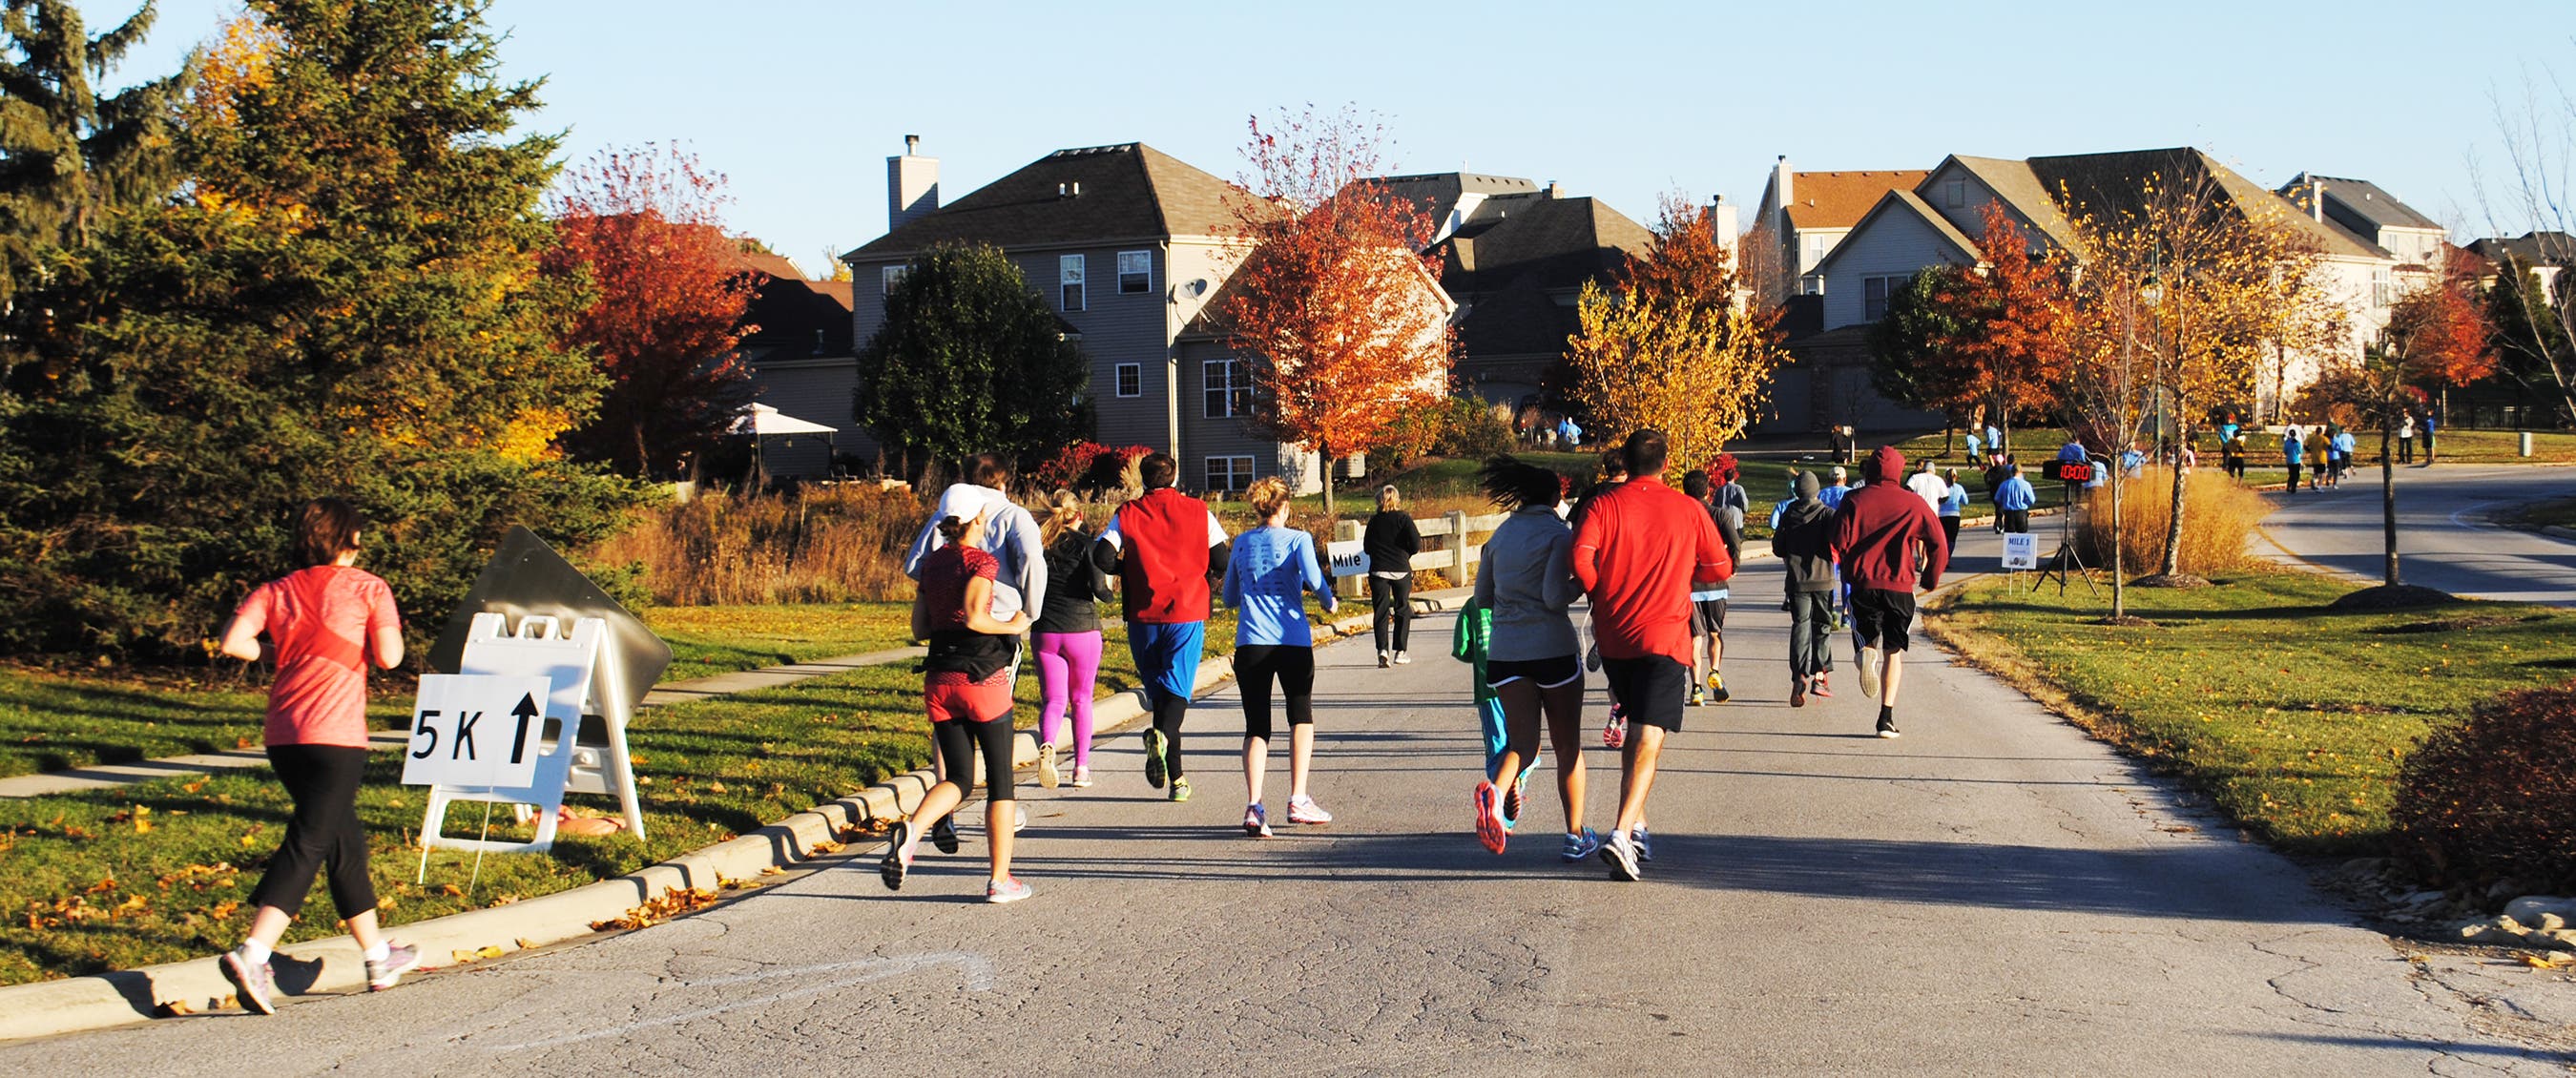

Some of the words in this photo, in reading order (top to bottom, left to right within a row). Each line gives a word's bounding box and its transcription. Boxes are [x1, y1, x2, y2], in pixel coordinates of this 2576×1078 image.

[2060, 465, 2090, 480] 10:00
[2008, 537, 2025, 546] MILE
[1333, 553, 1361, 568] Mile
